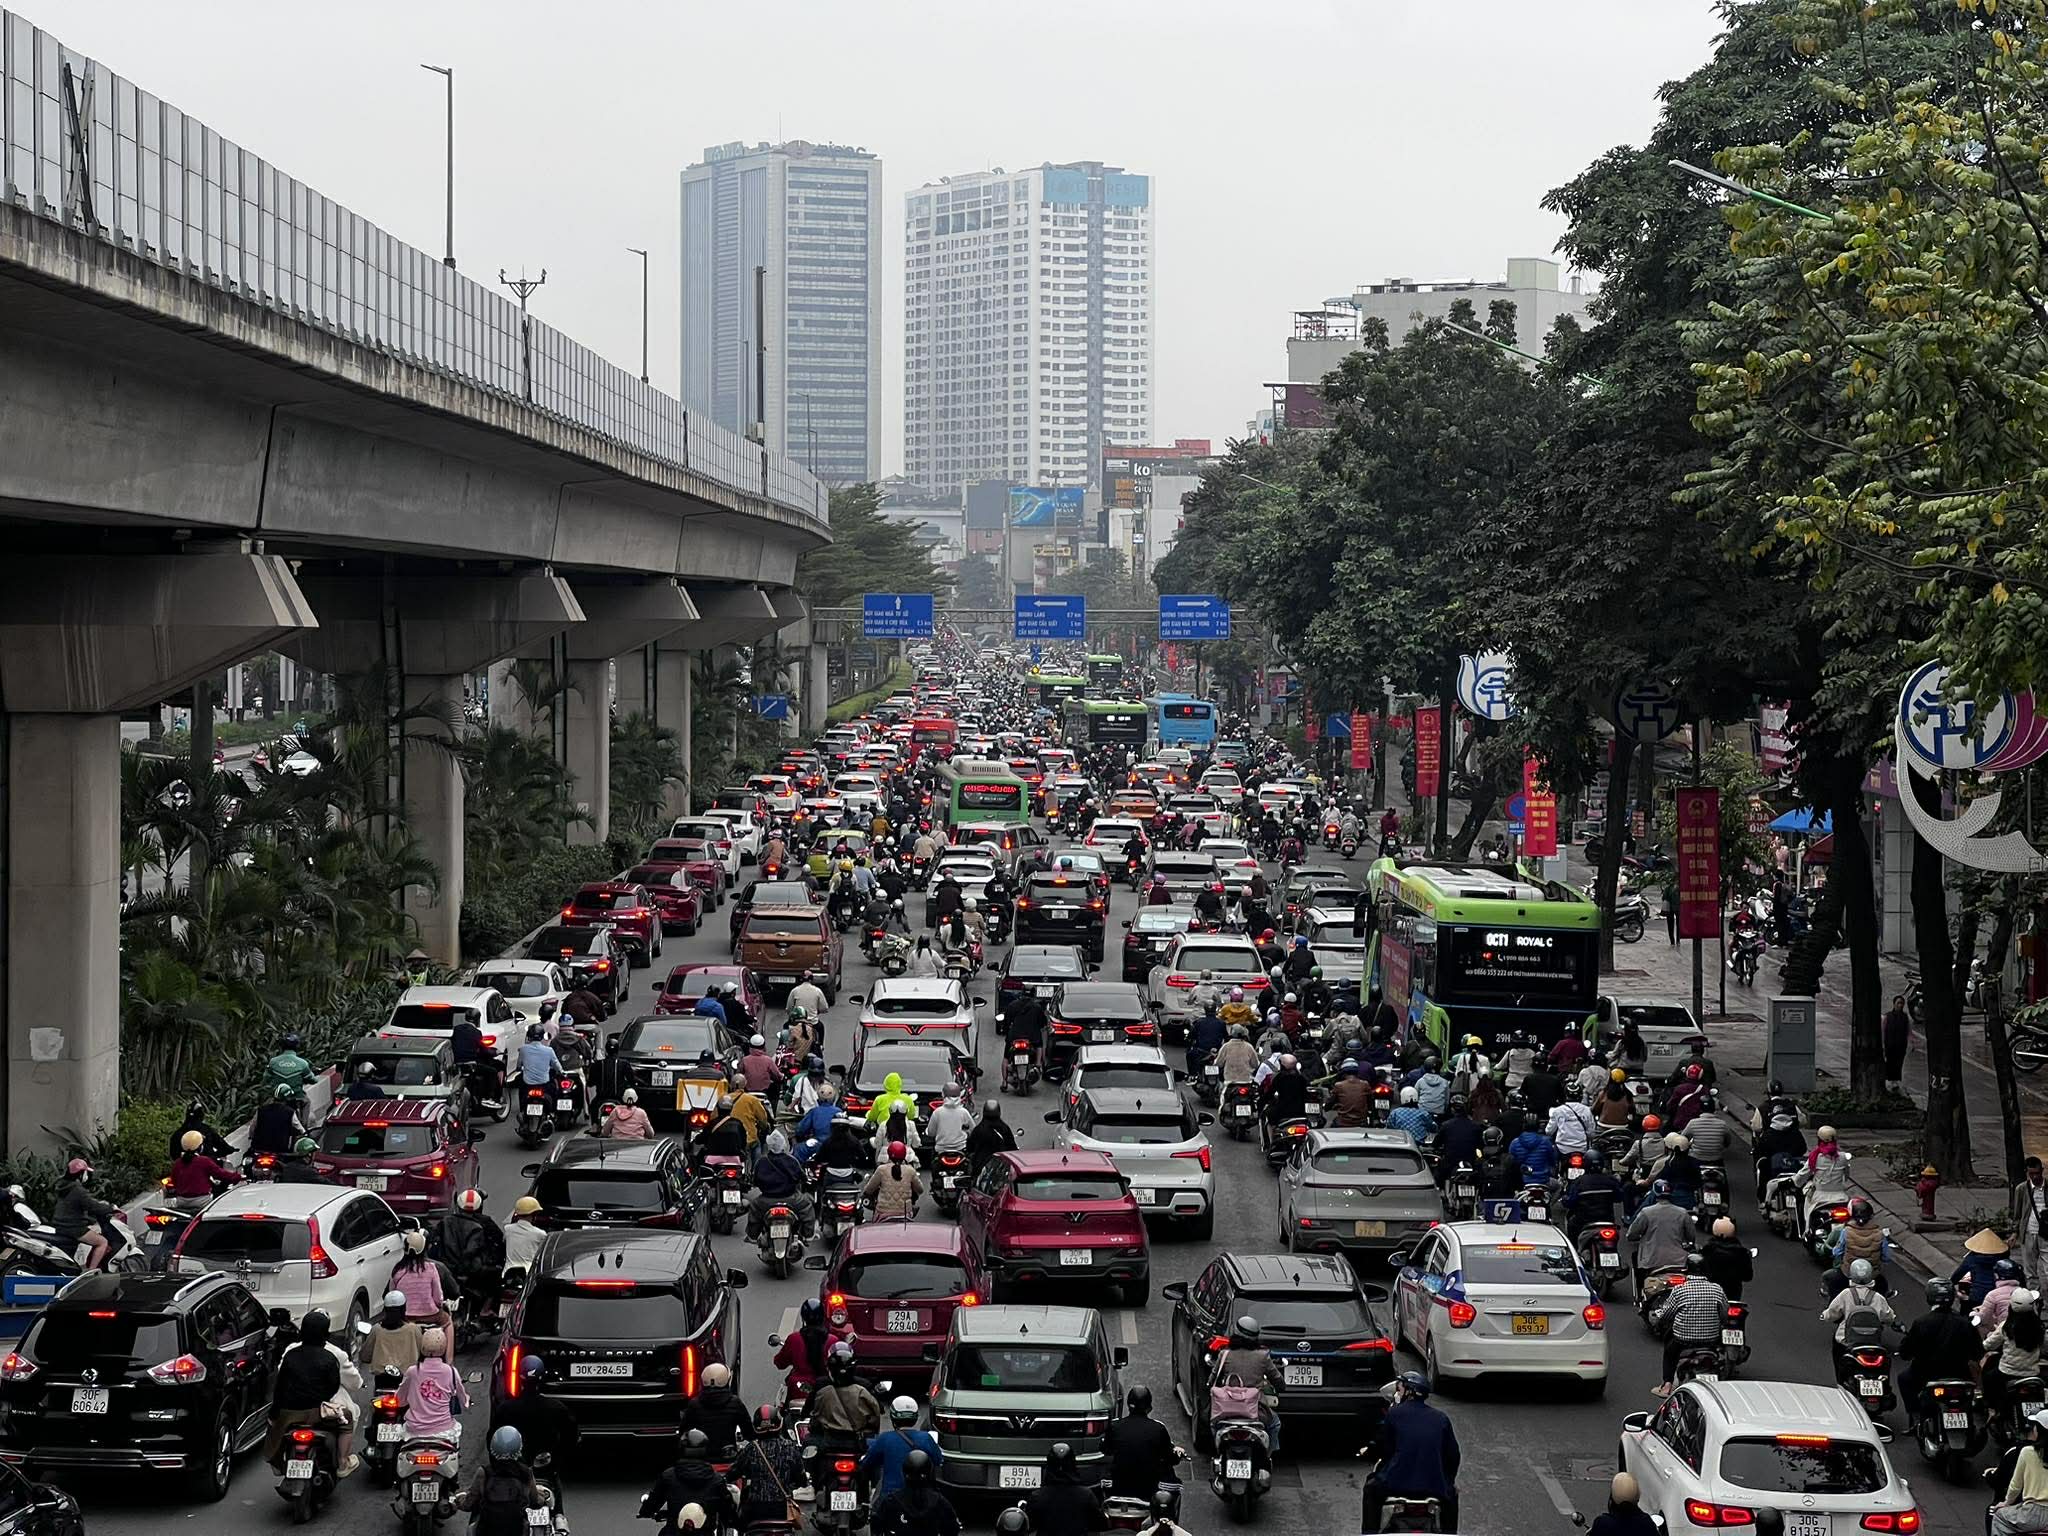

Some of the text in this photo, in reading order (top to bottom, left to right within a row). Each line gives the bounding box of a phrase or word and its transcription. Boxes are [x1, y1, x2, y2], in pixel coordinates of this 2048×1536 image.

[1516, 936, 1545, 947] ROYAL
[895, 1312, 910, 1320] 29A
[889, 1322, 917, 1330] 229.40
[576, 1366, 628, 1374] 30K-284.55
[1296, 1367, 1311, 1375] 30G
[1289, 1376, 1318, 1384] 751.75
[82, 1390, 99, 1400] 30F
[73, 1401, 106, 1412] 606.42
[1012, 1468, 1029, 1476] 89A
[1004, 1478, 1036, 1487] 537.64
[1800, 1516, 1818, 1525] 30G
